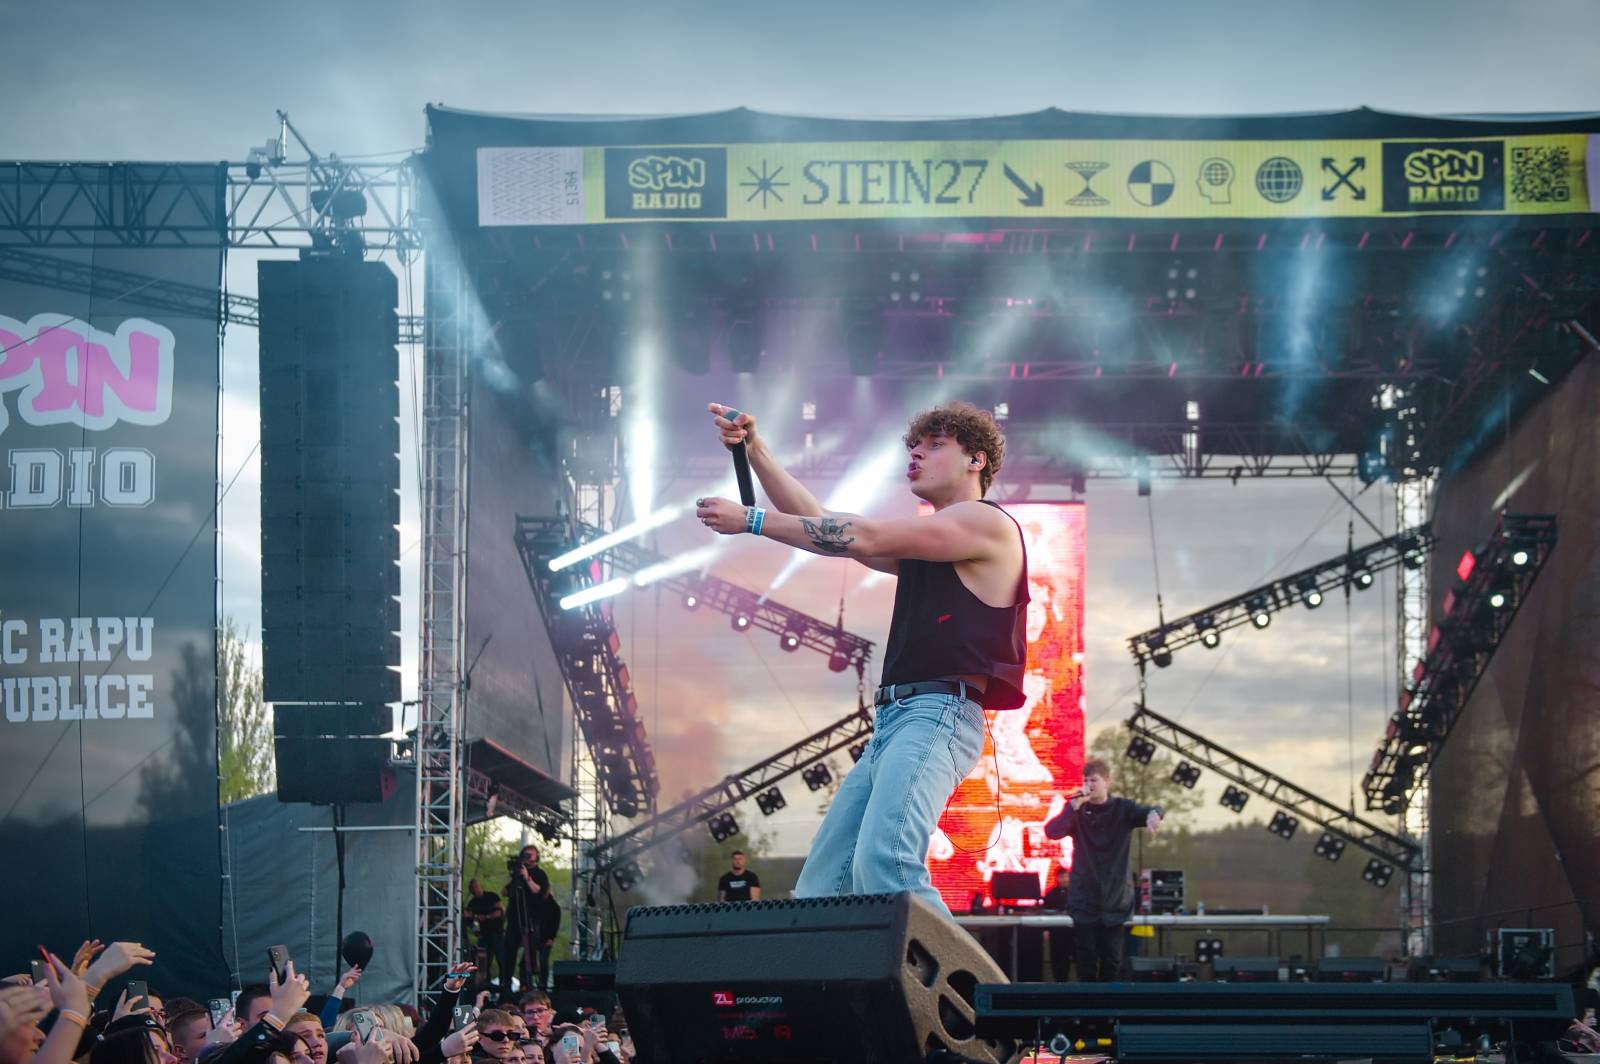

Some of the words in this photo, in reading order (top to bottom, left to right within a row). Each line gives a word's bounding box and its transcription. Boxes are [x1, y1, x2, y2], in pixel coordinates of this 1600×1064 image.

[628, 156, 705, 190] SPIN
[803, 160, 988, 204] STEIN27
[1404, 149, 1483, 184] SPIN
[632, 193, 702, 209] RADIO
[1408, 186, 1479, 203] RADIO
[0, 447, 155, 509] DIO
[0, 617, 27, 664] C
[40, 617, 154, 663] RAPU
[0, 674, 154, 722] UBLICE
